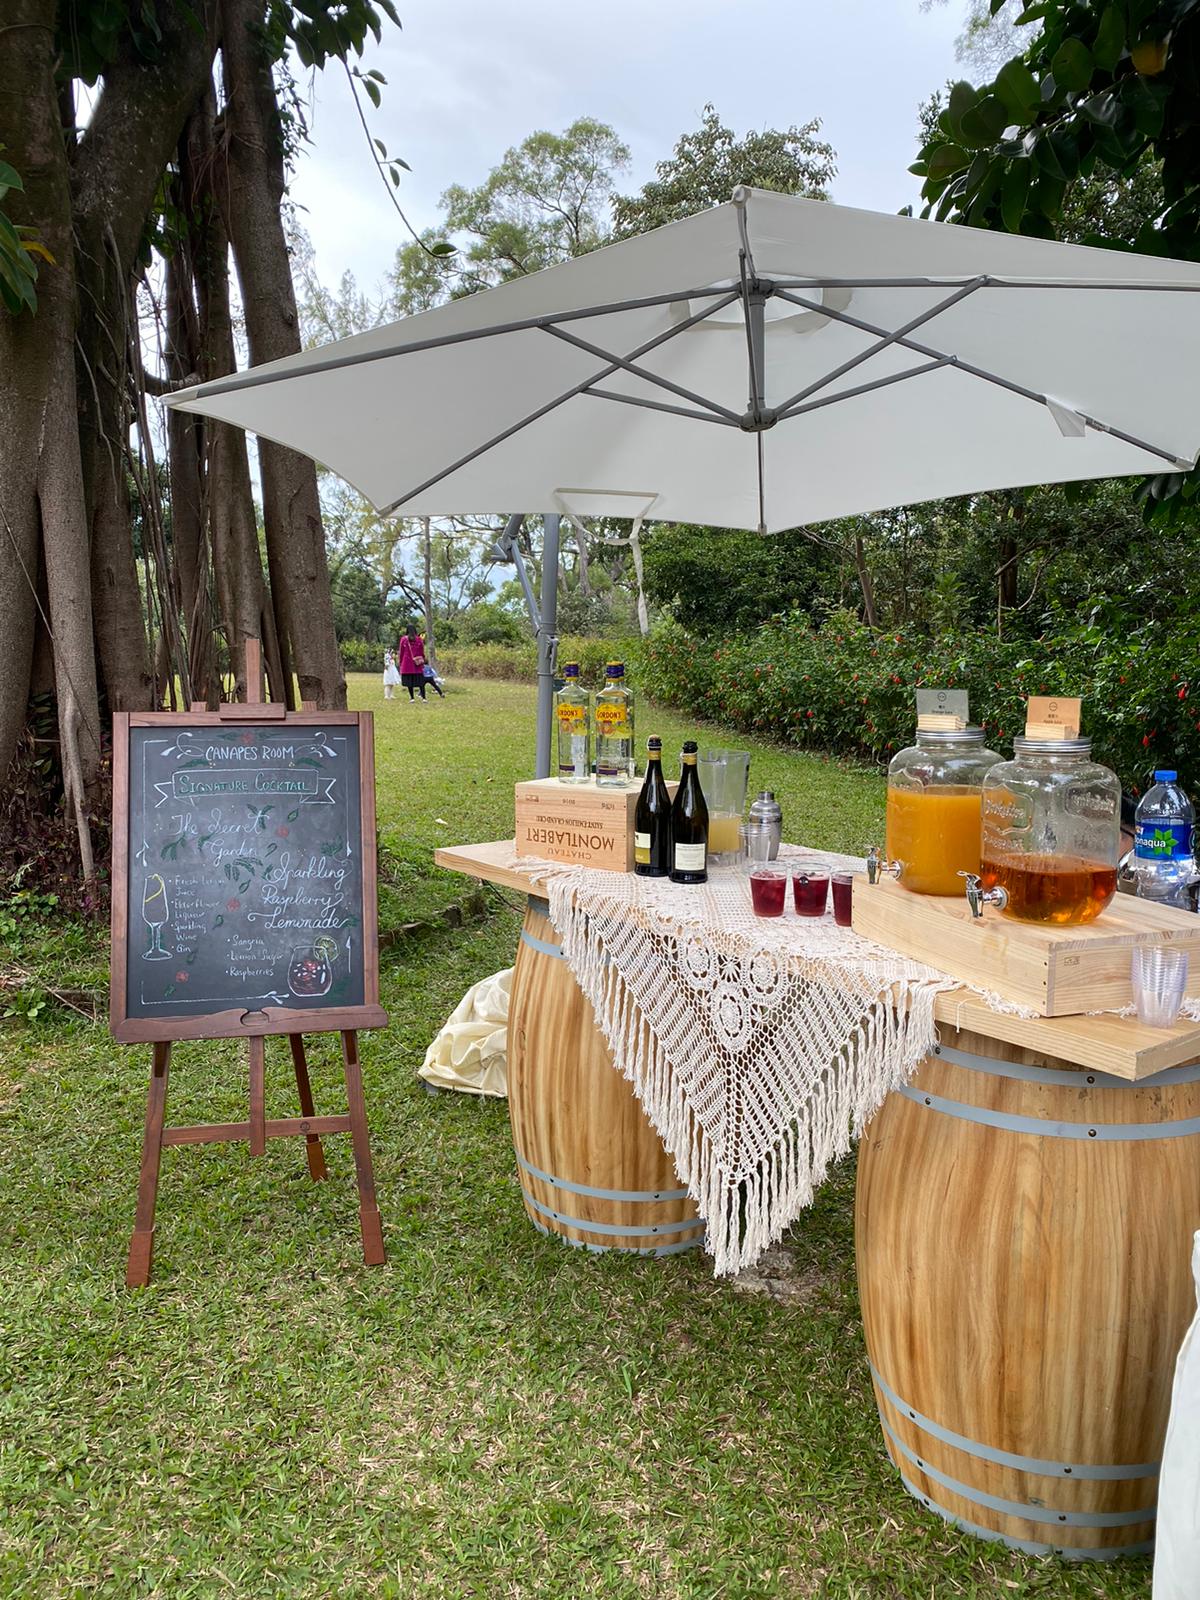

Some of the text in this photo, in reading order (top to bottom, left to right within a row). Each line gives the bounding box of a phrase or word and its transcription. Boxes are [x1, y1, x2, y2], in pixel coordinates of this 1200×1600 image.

[205, 745, 294, 761] CANAPES ROOM
[179, 771, 311, 794] SIGNATURE COCKTAIL
[171, 807, 270, 836] The Secret
[526, 827, 615, 852] MONTLABERT
[203, 839, 258, 867] Garden
[265, 852, 350, 891] Sparkling
[261, 883, 344, 917] Raspberry
[249, 906, 349, 929] Lemonade
[176, 943, 191, 953] Gin
[232, 934, 265, 951] Sangria
[230, 950, 257, 961] Lemon
[229, 968, 275, 983] Raspberries
